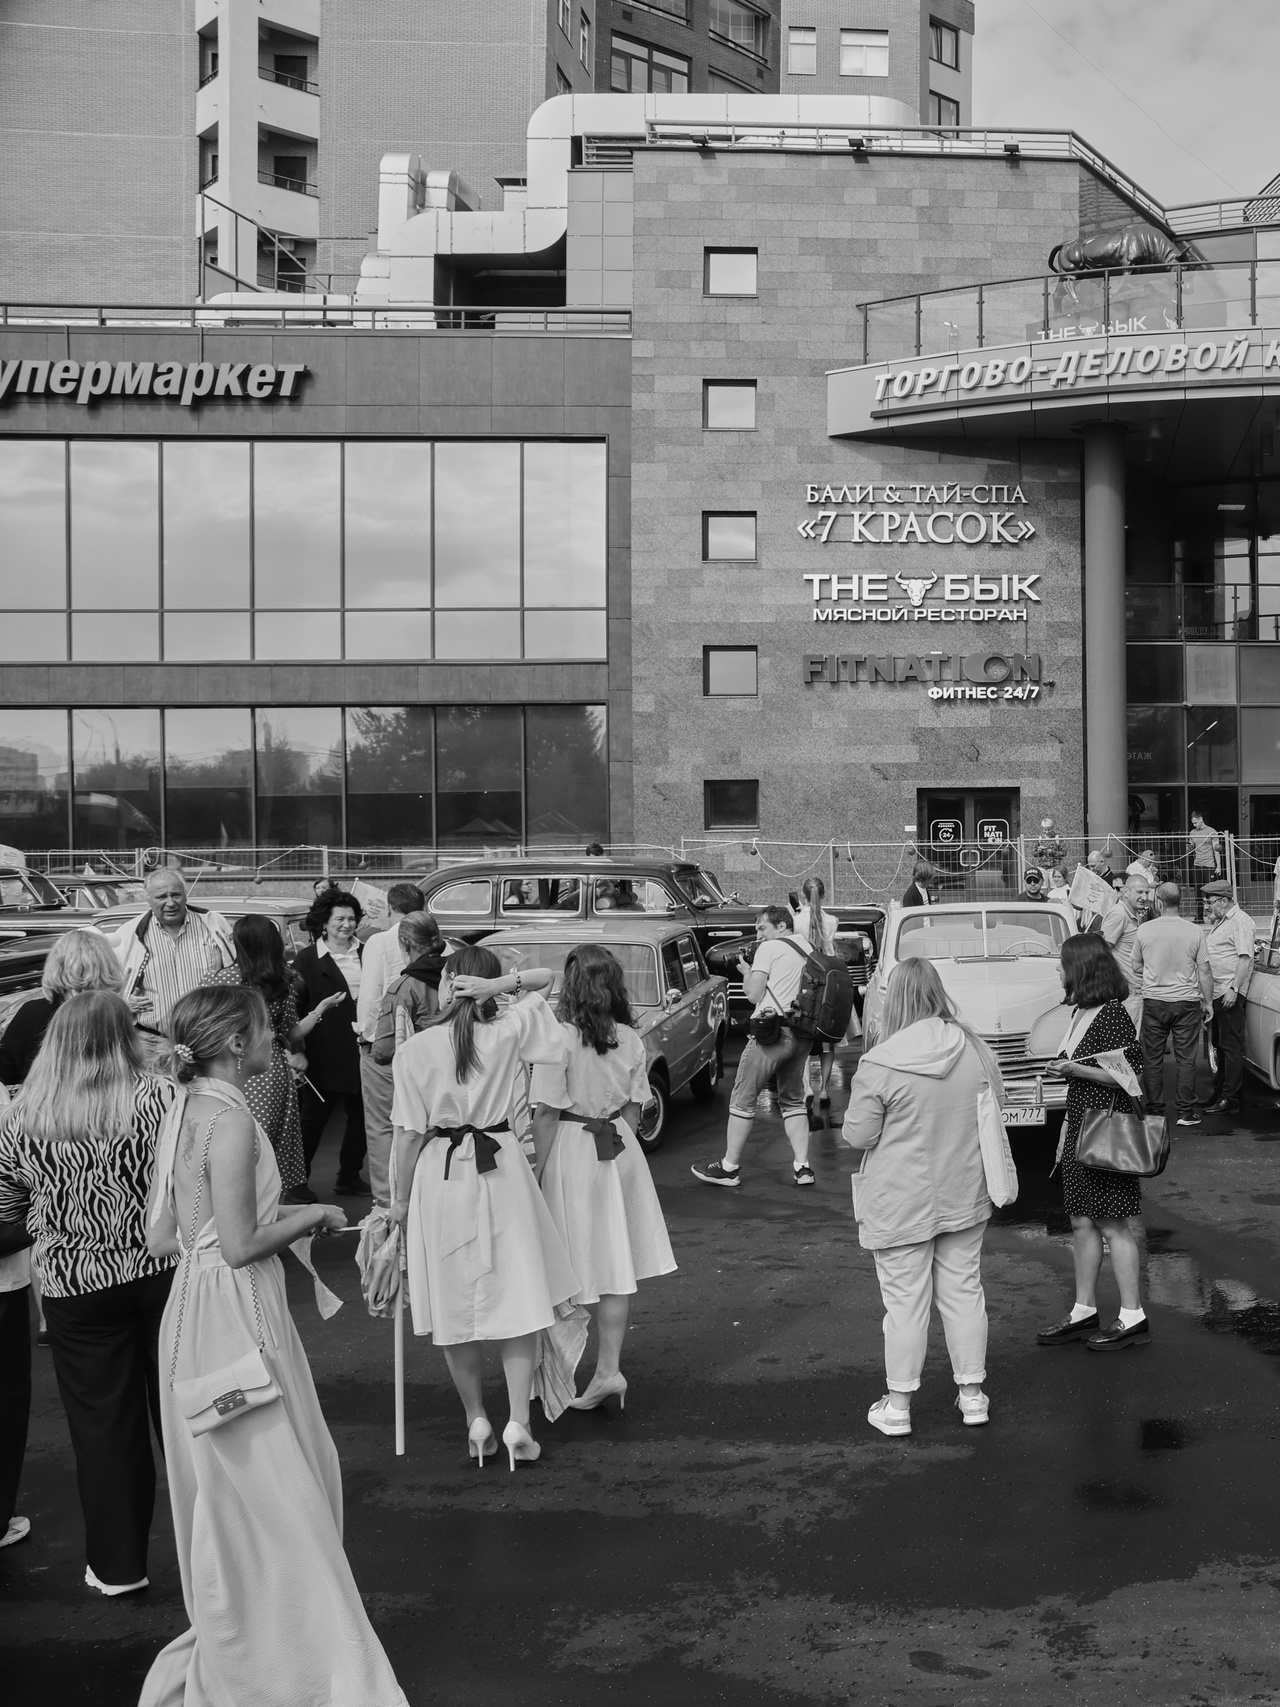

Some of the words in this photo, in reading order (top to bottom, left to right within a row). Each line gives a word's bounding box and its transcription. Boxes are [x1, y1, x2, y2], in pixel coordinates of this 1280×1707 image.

[873, 334, 1249, 401] ТОРГОВО-ДЕЛОВОЙ
[805, 484, 876, 504] БАЛИ
[883, 484, 903, 504] &
[909, 481, 1029, 504] ТАЙ-СПА
[851, 510, 1036, 544] КРАСОК»
[803, 573, 889, 601] THE
[944, 573, 1042, 601] БЫК
[812, 604, 909, 622] МЯСНОЙ
[914, 608, 1028, 622] РЕСТОРАН
[802, 651, 1041, 683] FITNATION
[927, 685, 998, 700] ФИТНЕС
[1003, 685, 1041, 700] 24/7
[1001, 1112, 1019, 1123] ОМ
[1021, 1108, 1041, 1119] 777
